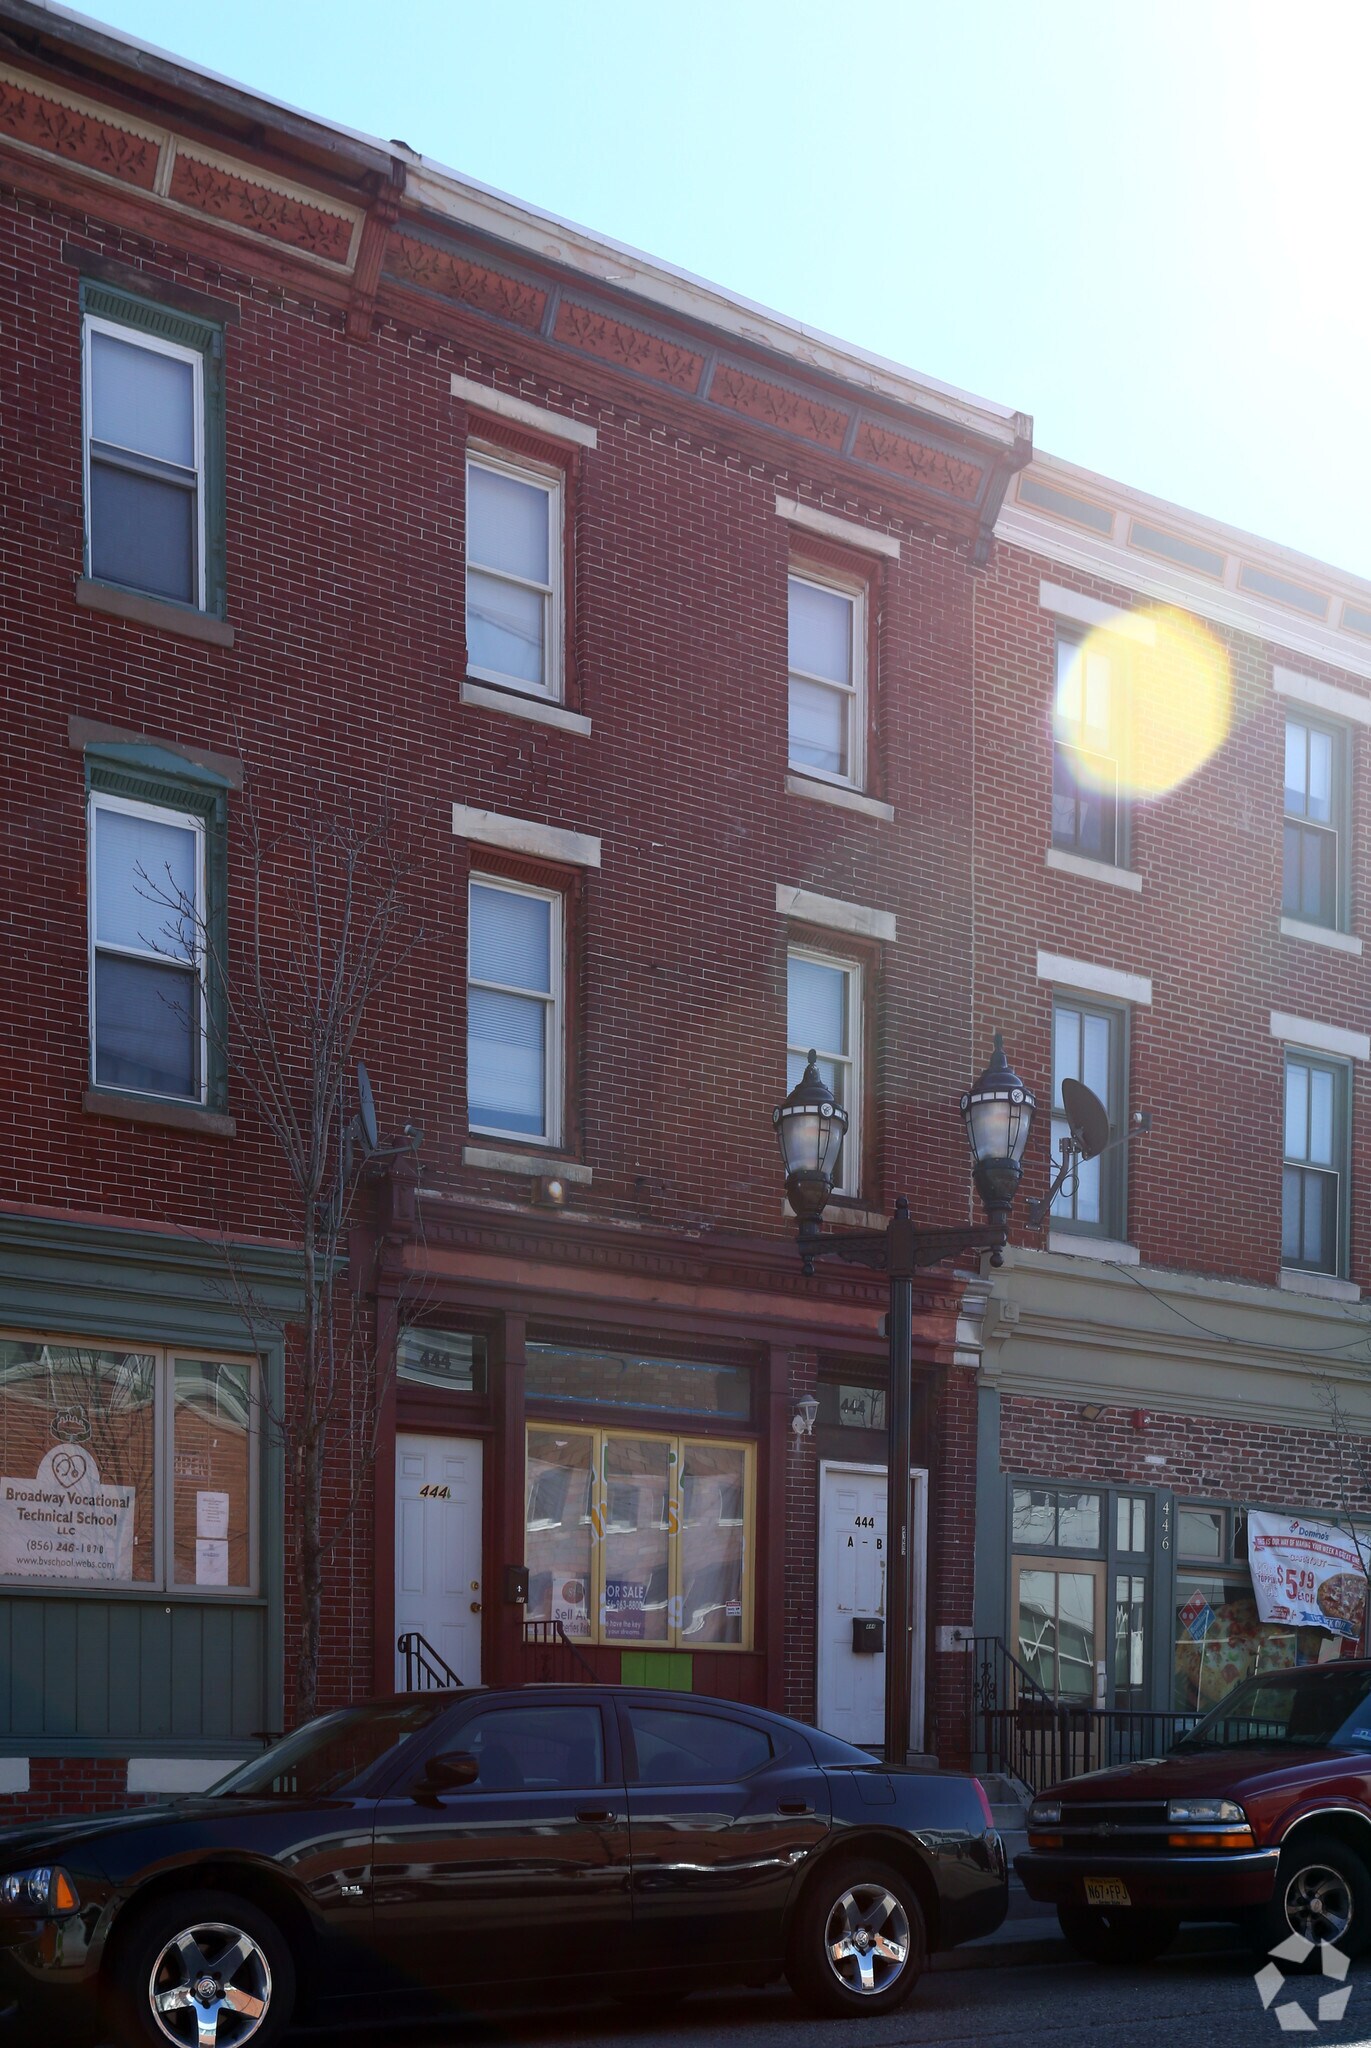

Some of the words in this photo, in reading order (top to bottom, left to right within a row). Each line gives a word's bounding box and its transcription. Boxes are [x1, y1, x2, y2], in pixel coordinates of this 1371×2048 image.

[420, 1351, 451, 1370] 444
[841, 1398, 865, 1416] 444
[6, 1488, 65, 1507] Broadway
[67, 1492, 130, 1508] Vocational
[420, 1485, 448, 1499] 444
[17, 1507, 73, 1524] Technical
[76, 1512, 117, 1526] School
[854, 1516, 875, 1529] 444
[57, 1527, 76, 1535] LLC
[27, 1540, 53, 1552] (856)
[848, 1535, 854, 1547] A
[876, 1539, 883, 1550] B
[606, 1585, 620, 1597] OR
[622, 1586, 643, 1598] SALE
[555, 1608, 573, 1620] Sell
